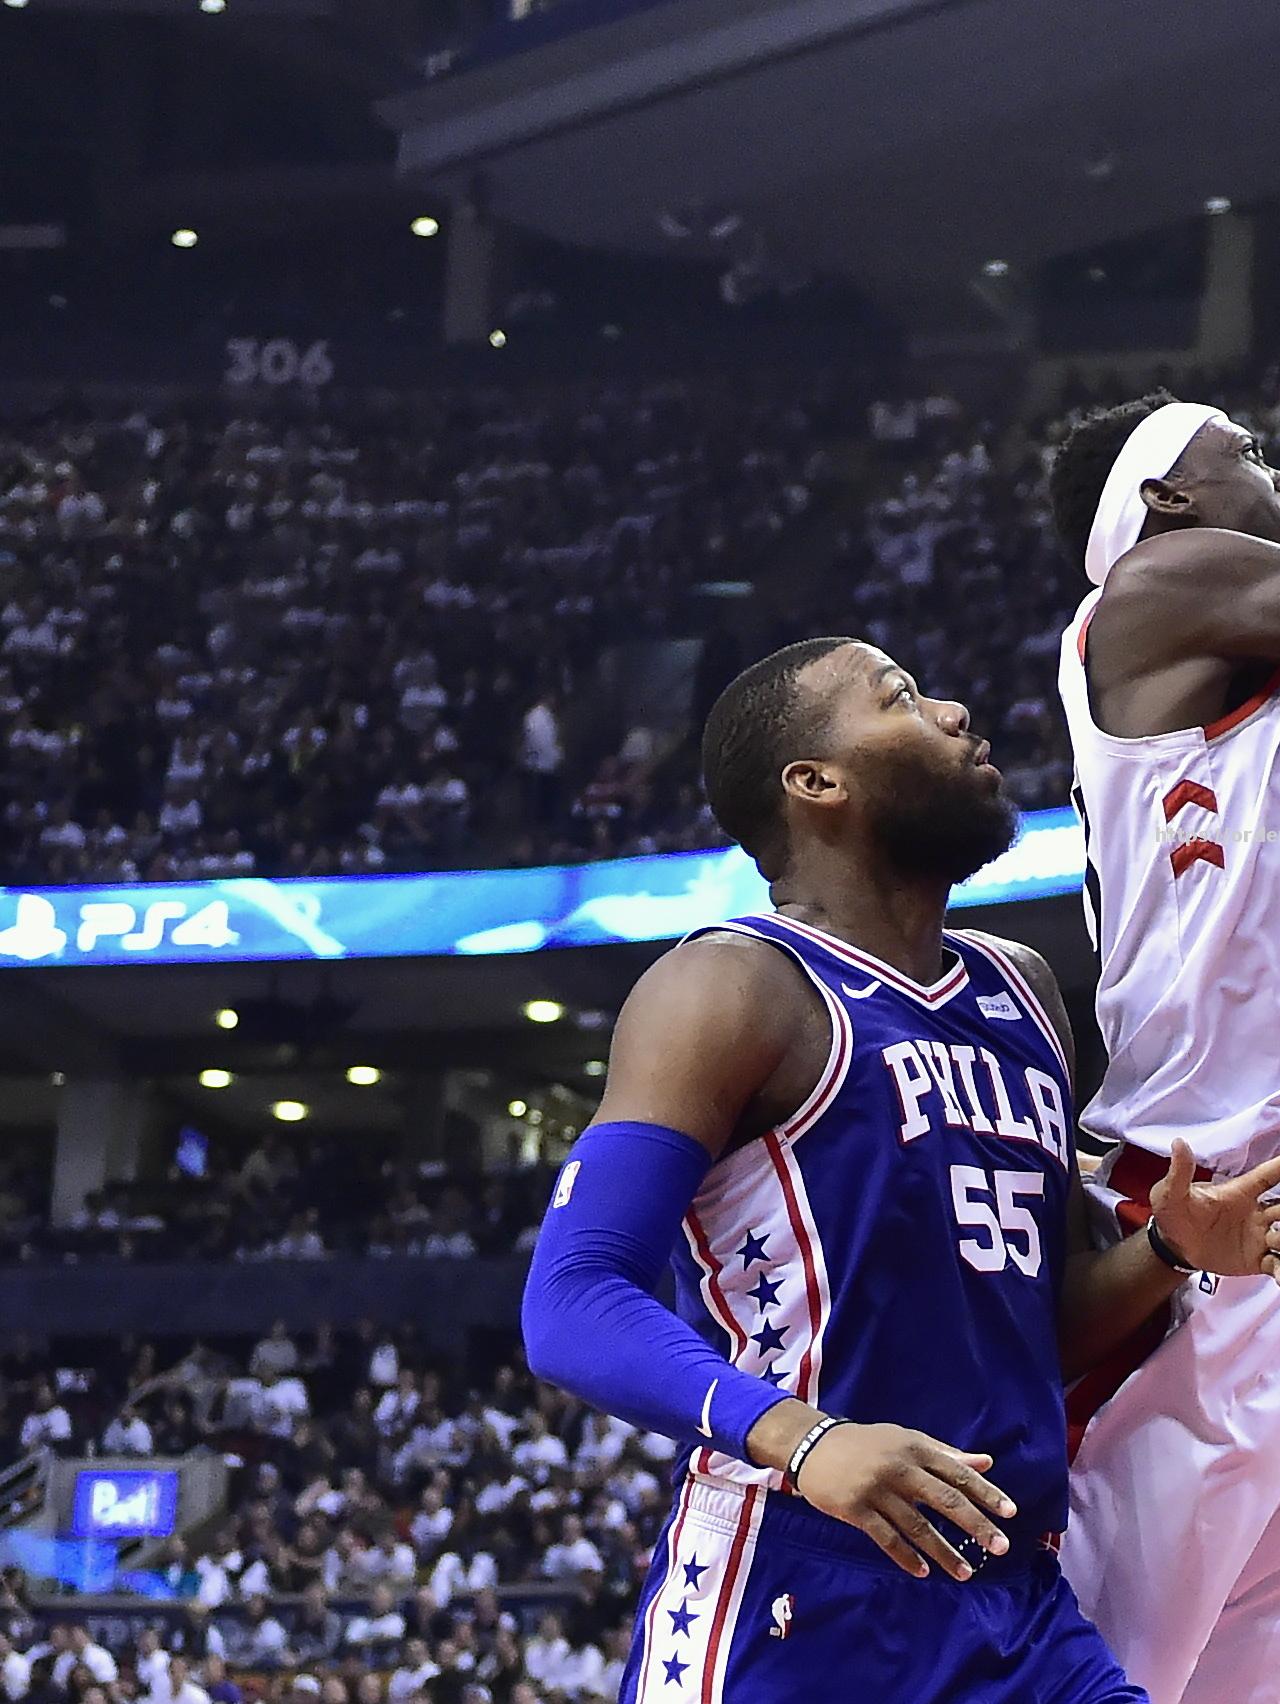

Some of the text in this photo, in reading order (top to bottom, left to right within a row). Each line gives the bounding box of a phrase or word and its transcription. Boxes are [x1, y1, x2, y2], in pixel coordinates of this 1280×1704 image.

[225, 338, 334, 384] 306
[77, 900, 240, 952] PS4
[881, 1039, 1069, 1174] PHILA
[950, 1165, 1045, 1279] 55
